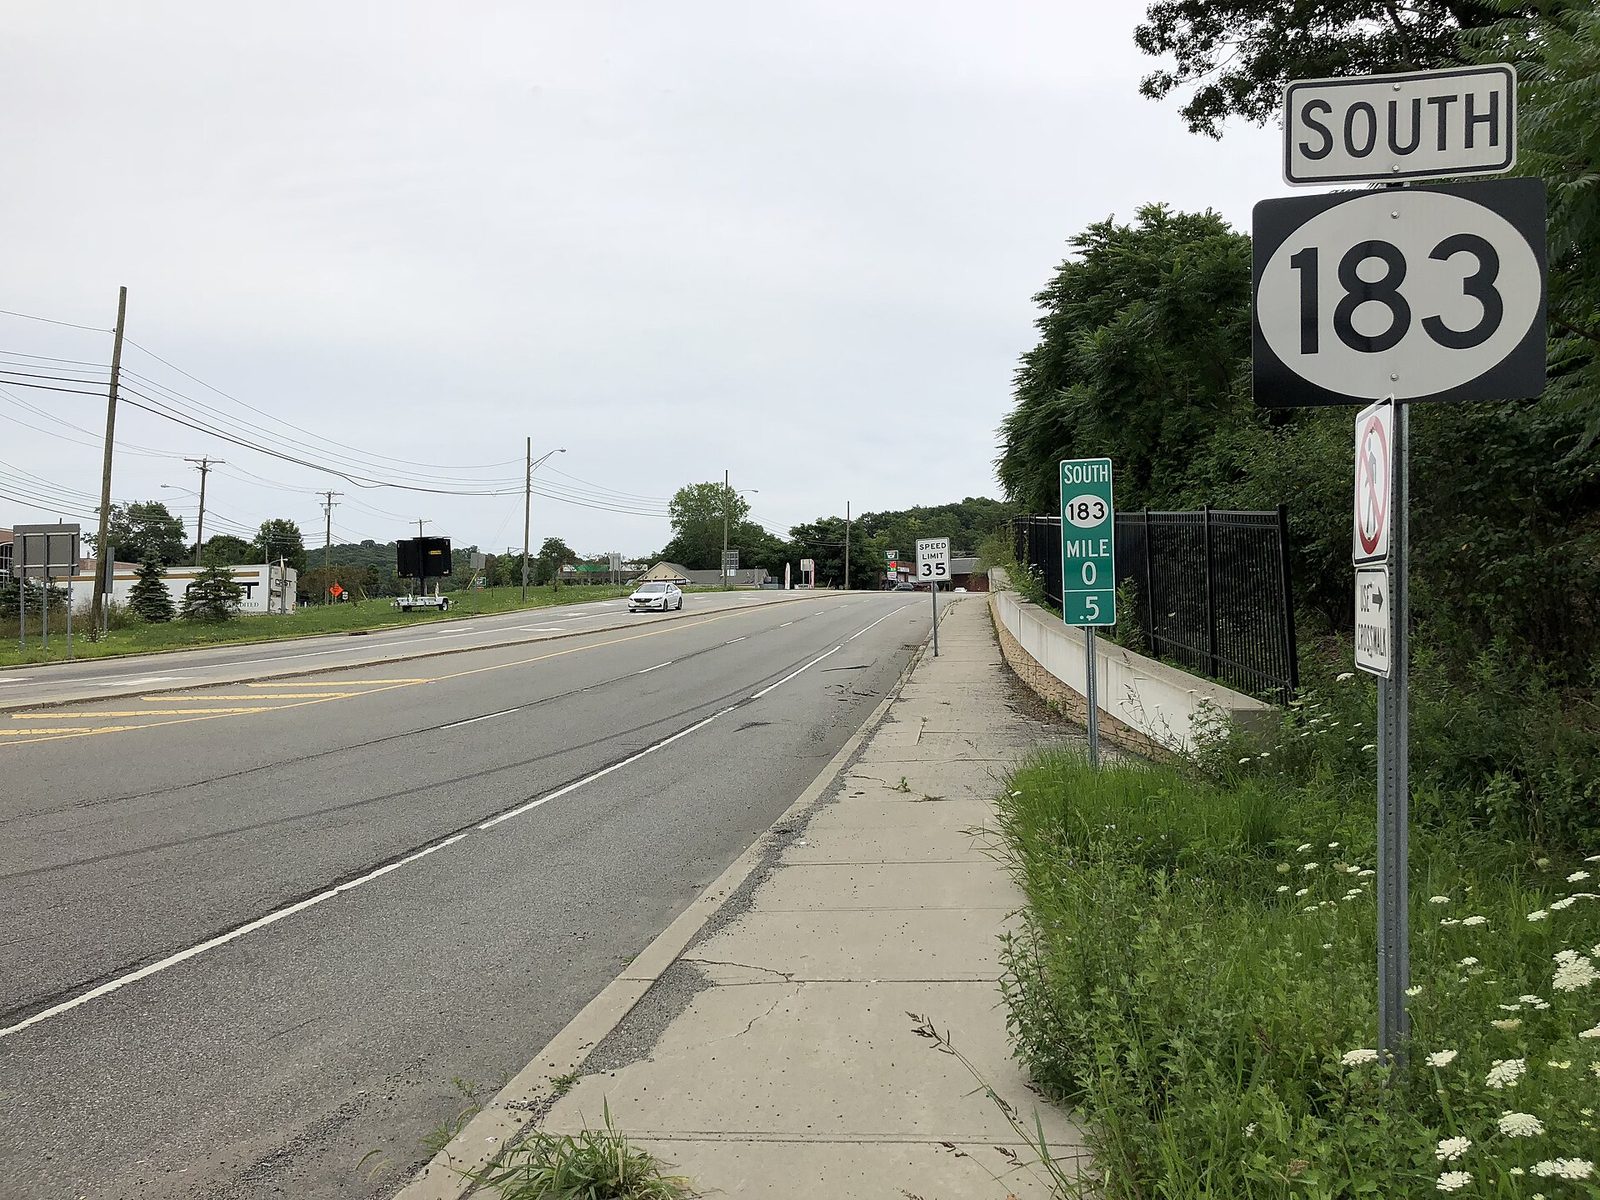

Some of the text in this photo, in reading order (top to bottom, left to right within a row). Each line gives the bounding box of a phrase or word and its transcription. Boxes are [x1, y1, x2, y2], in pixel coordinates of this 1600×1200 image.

[1298, 91, 1499, 160] SOUTH
[1290, 233, 1504, 355] 183
[1064, 464, 1109, 484] SOUTH
[1068, 501, 1105, 521] 183
[919, 542, 947, 550] SPEED
[922, 552, 944, 560] LIMIT
[1066, 539, 1110, 558] MILE
[921, 562, 946, 576] 35
[1081, 561, 1097, 586] 0
